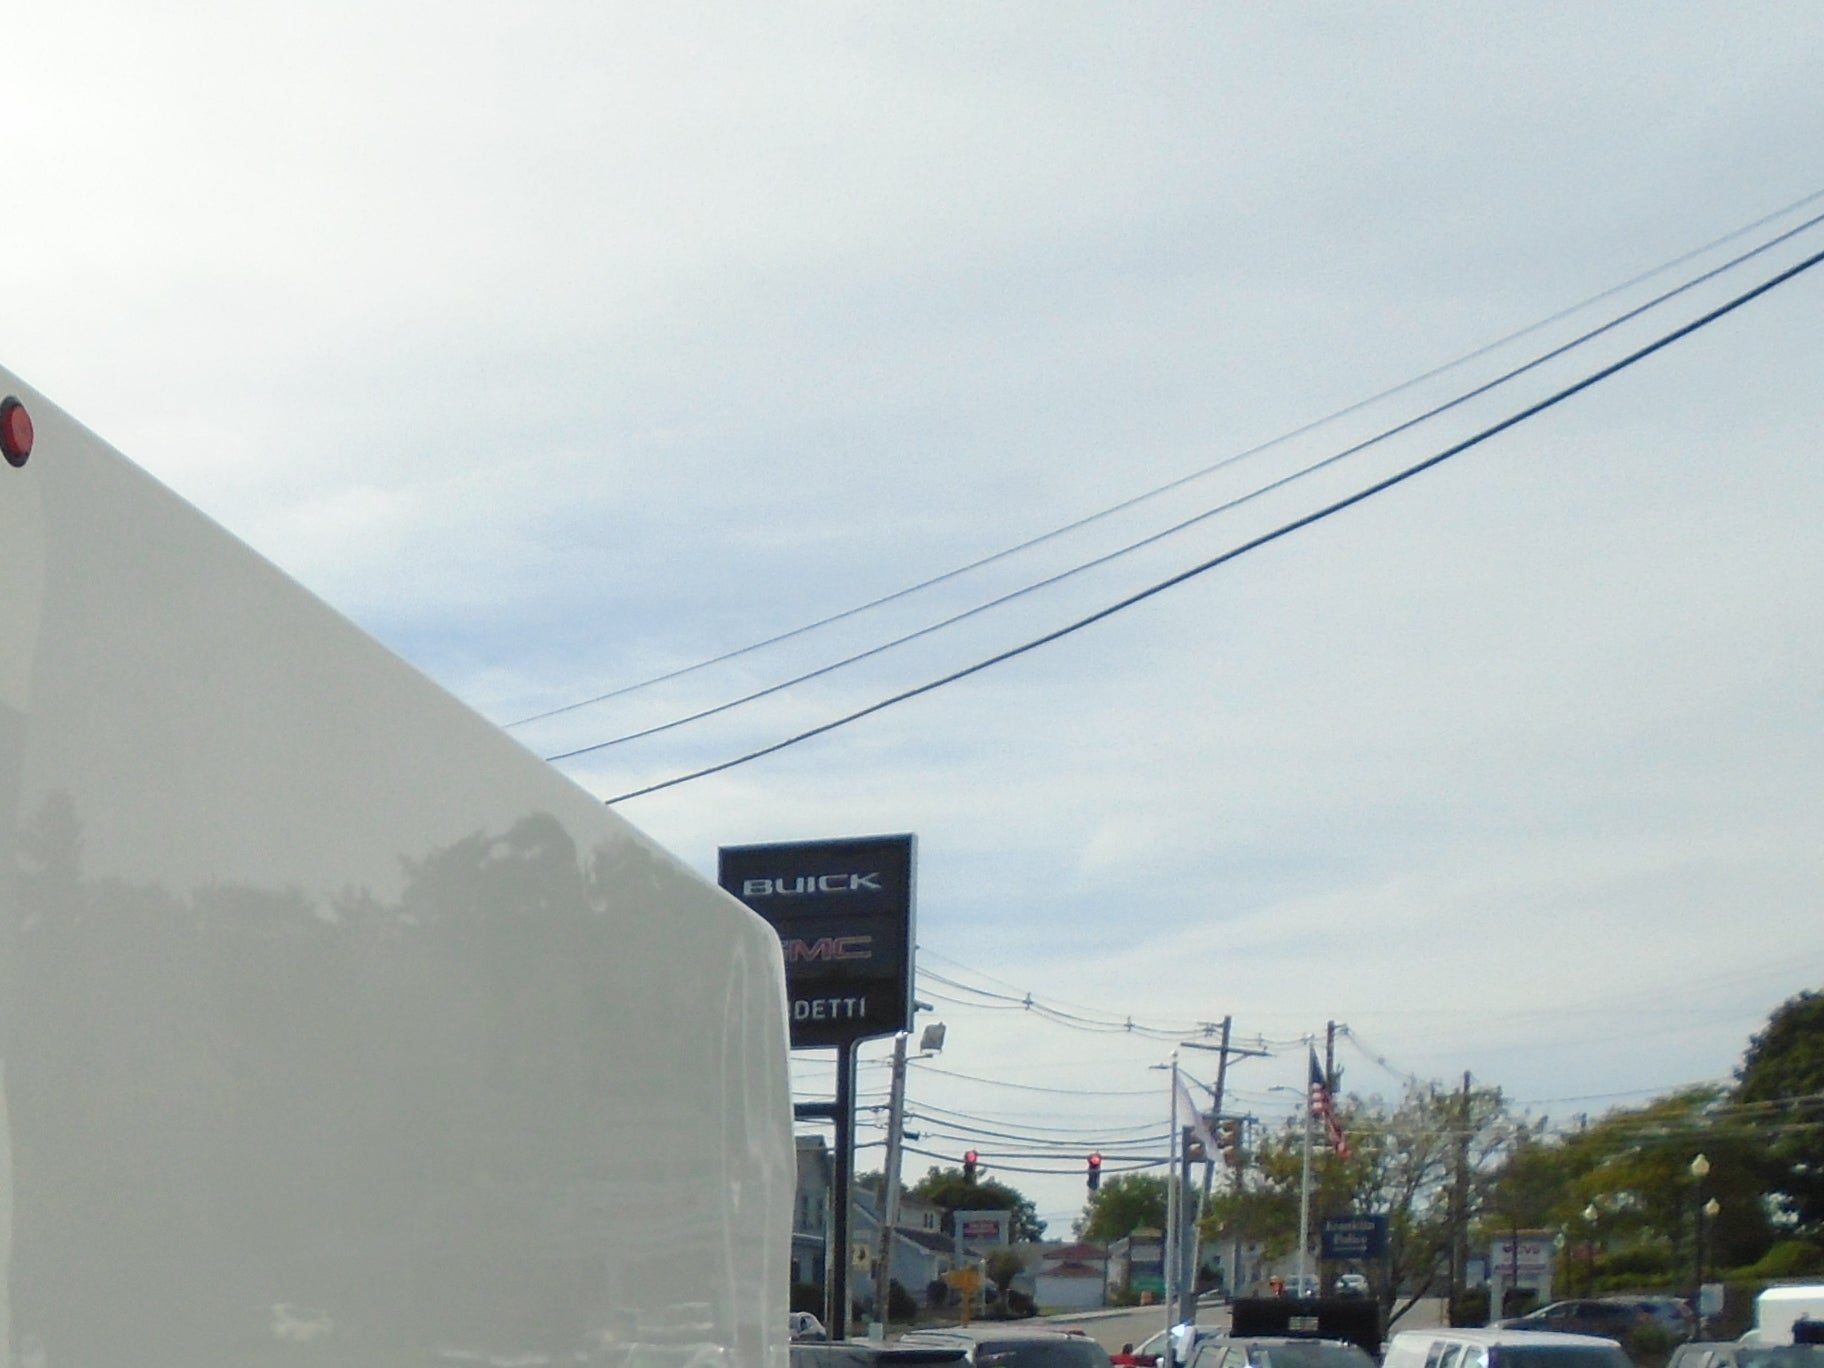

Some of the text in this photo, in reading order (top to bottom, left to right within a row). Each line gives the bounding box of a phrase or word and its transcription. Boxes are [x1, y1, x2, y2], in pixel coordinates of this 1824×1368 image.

[742, 872, 882, 896] BUICK
[783, 935, 873, 963] MC
[789, 997, 866, 1020] DETTI
